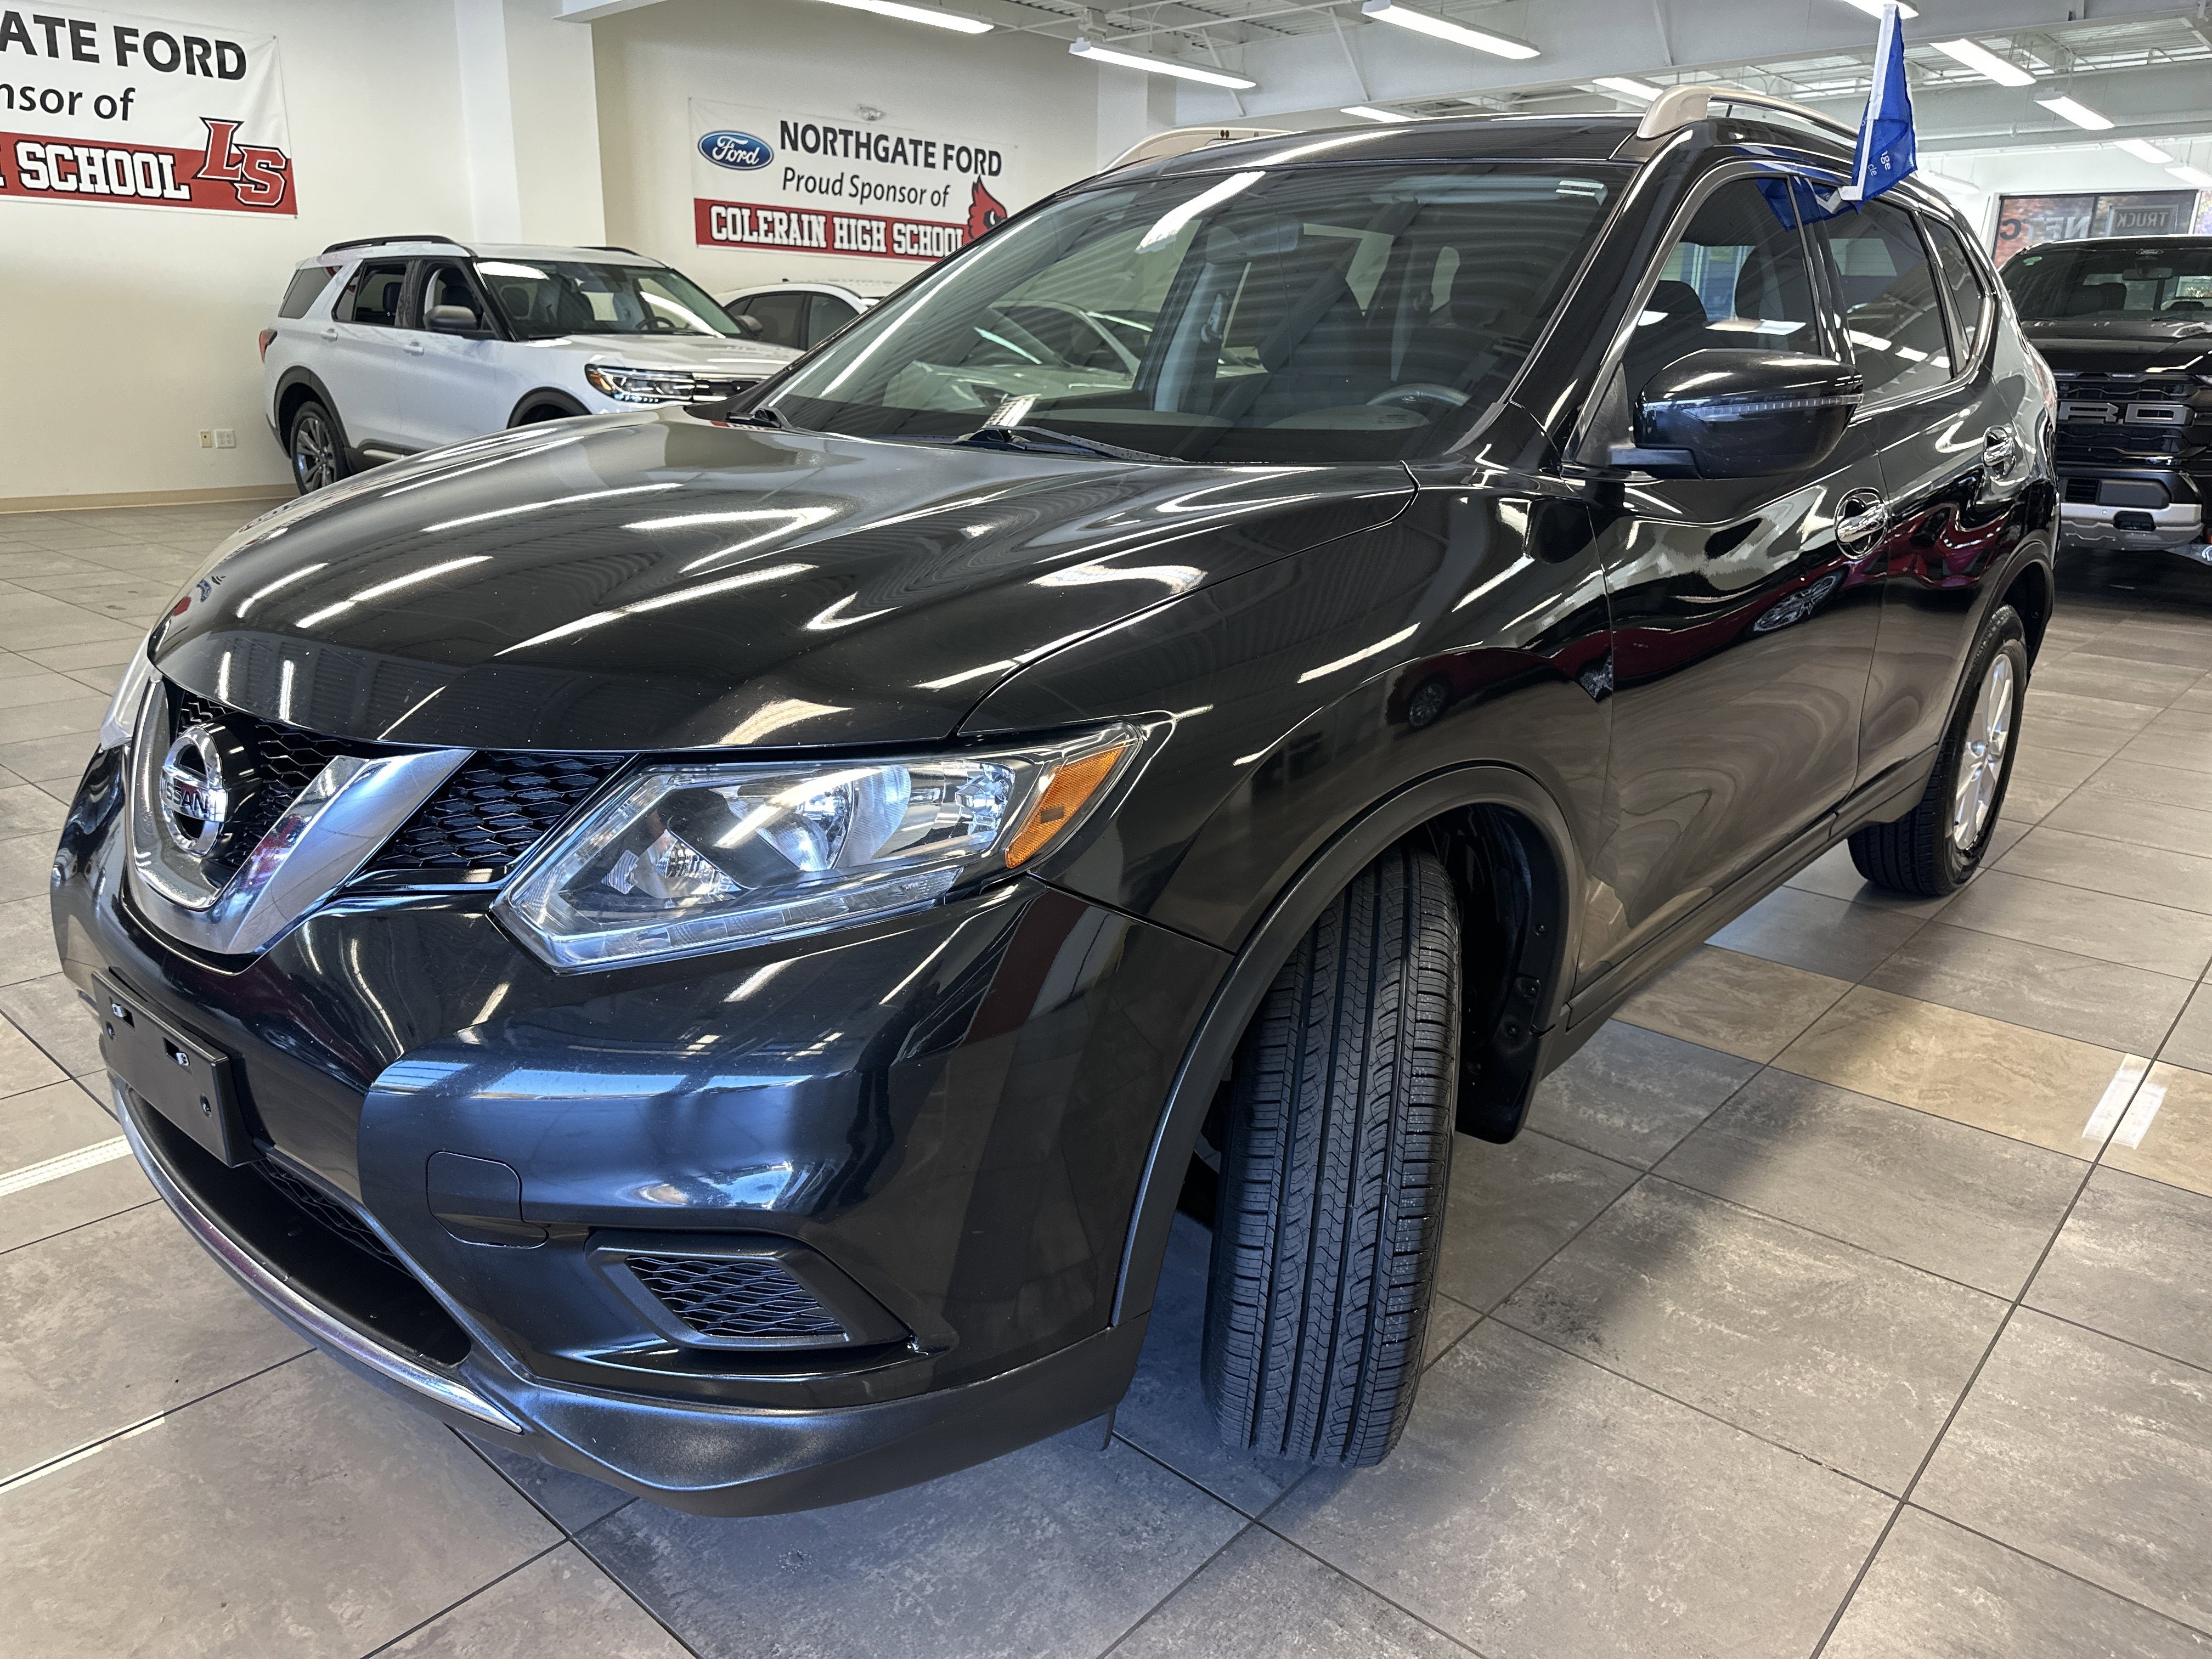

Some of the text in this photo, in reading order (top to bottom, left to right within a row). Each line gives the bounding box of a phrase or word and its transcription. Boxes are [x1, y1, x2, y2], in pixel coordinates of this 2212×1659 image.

[0, 10, 246, 80] ATE FORD
[94, 87, 136, 121] of
[14, 139, 192, 201] SCHOOL
[191, 117, 287, 208] LS
[712, 136, 760, 165] Ford
[780, 120, 1002, 177] NORTHGATE FORD
[783, 167, 950, 207] Proud Sponsor of
[710, 205, 827, 249] COLERAIN
[833, 216, 887, 253] HIGH
